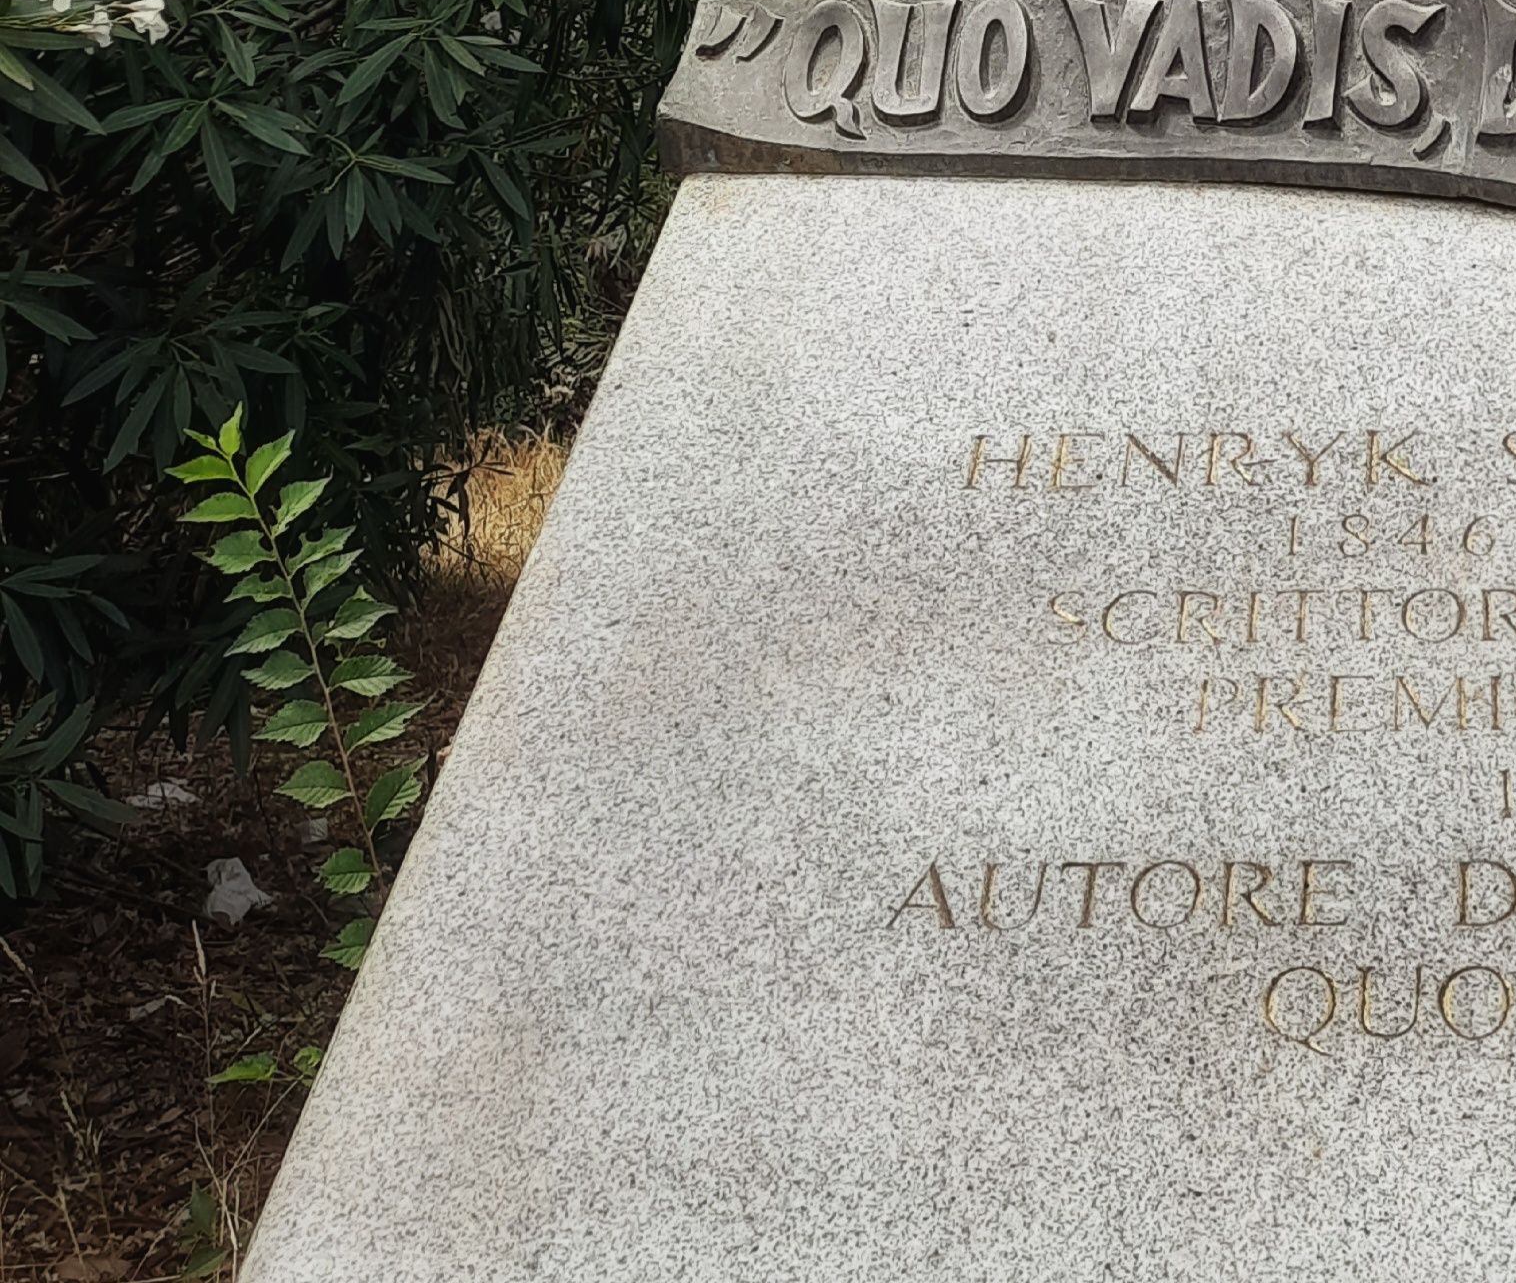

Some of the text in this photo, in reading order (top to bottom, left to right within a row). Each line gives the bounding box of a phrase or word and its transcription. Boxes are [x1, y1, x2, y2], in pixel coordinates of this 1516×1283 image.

[963, 430, 1428, 490] HENRYK
[1288, 513, 1496, 558] 1846
[887, 859, 1352, 929] AUTORE
[1264, 965, 1512, 1057] QUO
